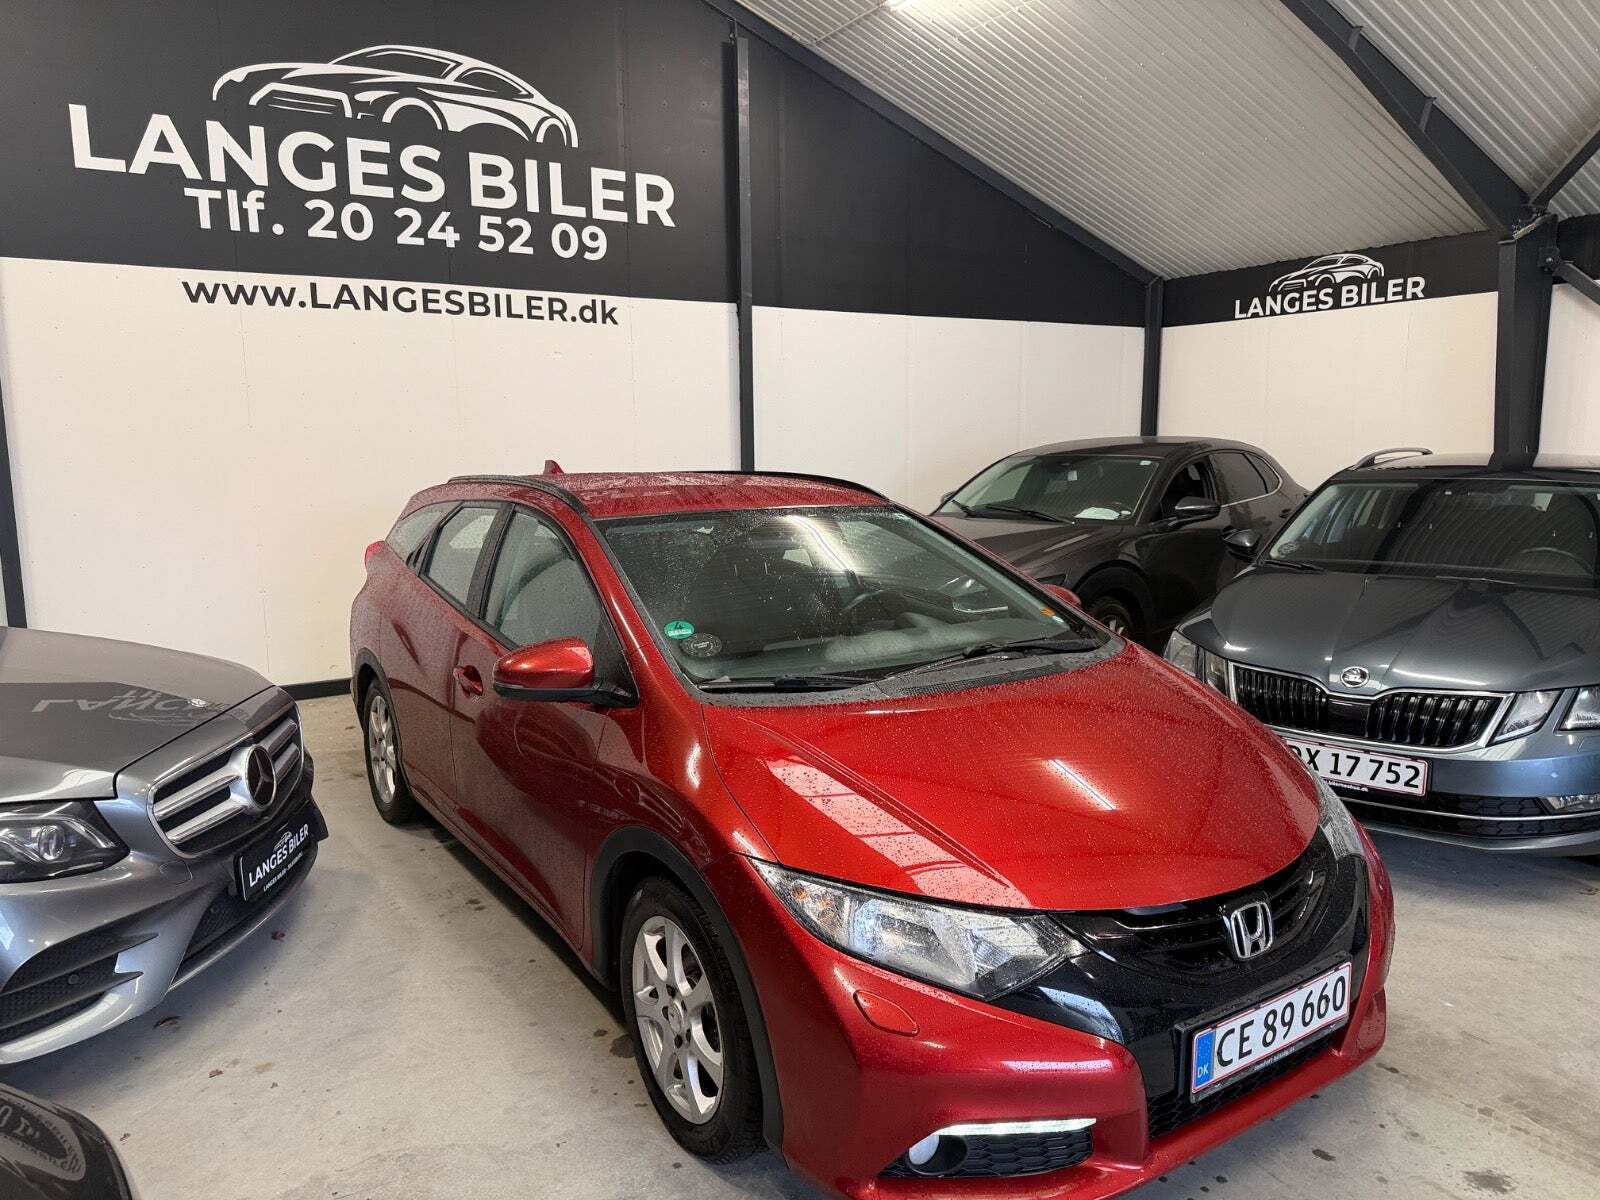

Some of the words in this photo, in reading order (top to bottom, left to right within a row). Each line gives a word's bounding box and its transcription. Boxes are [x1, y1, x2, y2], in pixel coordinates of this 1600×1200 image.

[69, 103, 446, 203] LANGES
[468, 151, 676, 228] BILER
[183, 187, 285, 236] Tlf.
[304, 199, 374, 241] 20
[394, 207, 460, 248] 24
[478, 214, 534, 255] 52
[551, 222, 608, 261] 09
[181, 280, 619, 326] www.LANGESBILER.dk
[1234, 287, 1334, 319] LANGES
[1340, 276, 1426, 307] BILER
[1330, 752, 1360, 777] 17
[1368, 758, 1420, 788] 752
[249, 844, 288, 888] LANGES
[288, 823, 309, 855] BILER
[1217, 1019, 1255, 1067] CE
[1261, 1001, 1295, 1048] 89
[1301, 975, 1346, 1028] 660
[1197, 1062, 1209, 1079] DK
